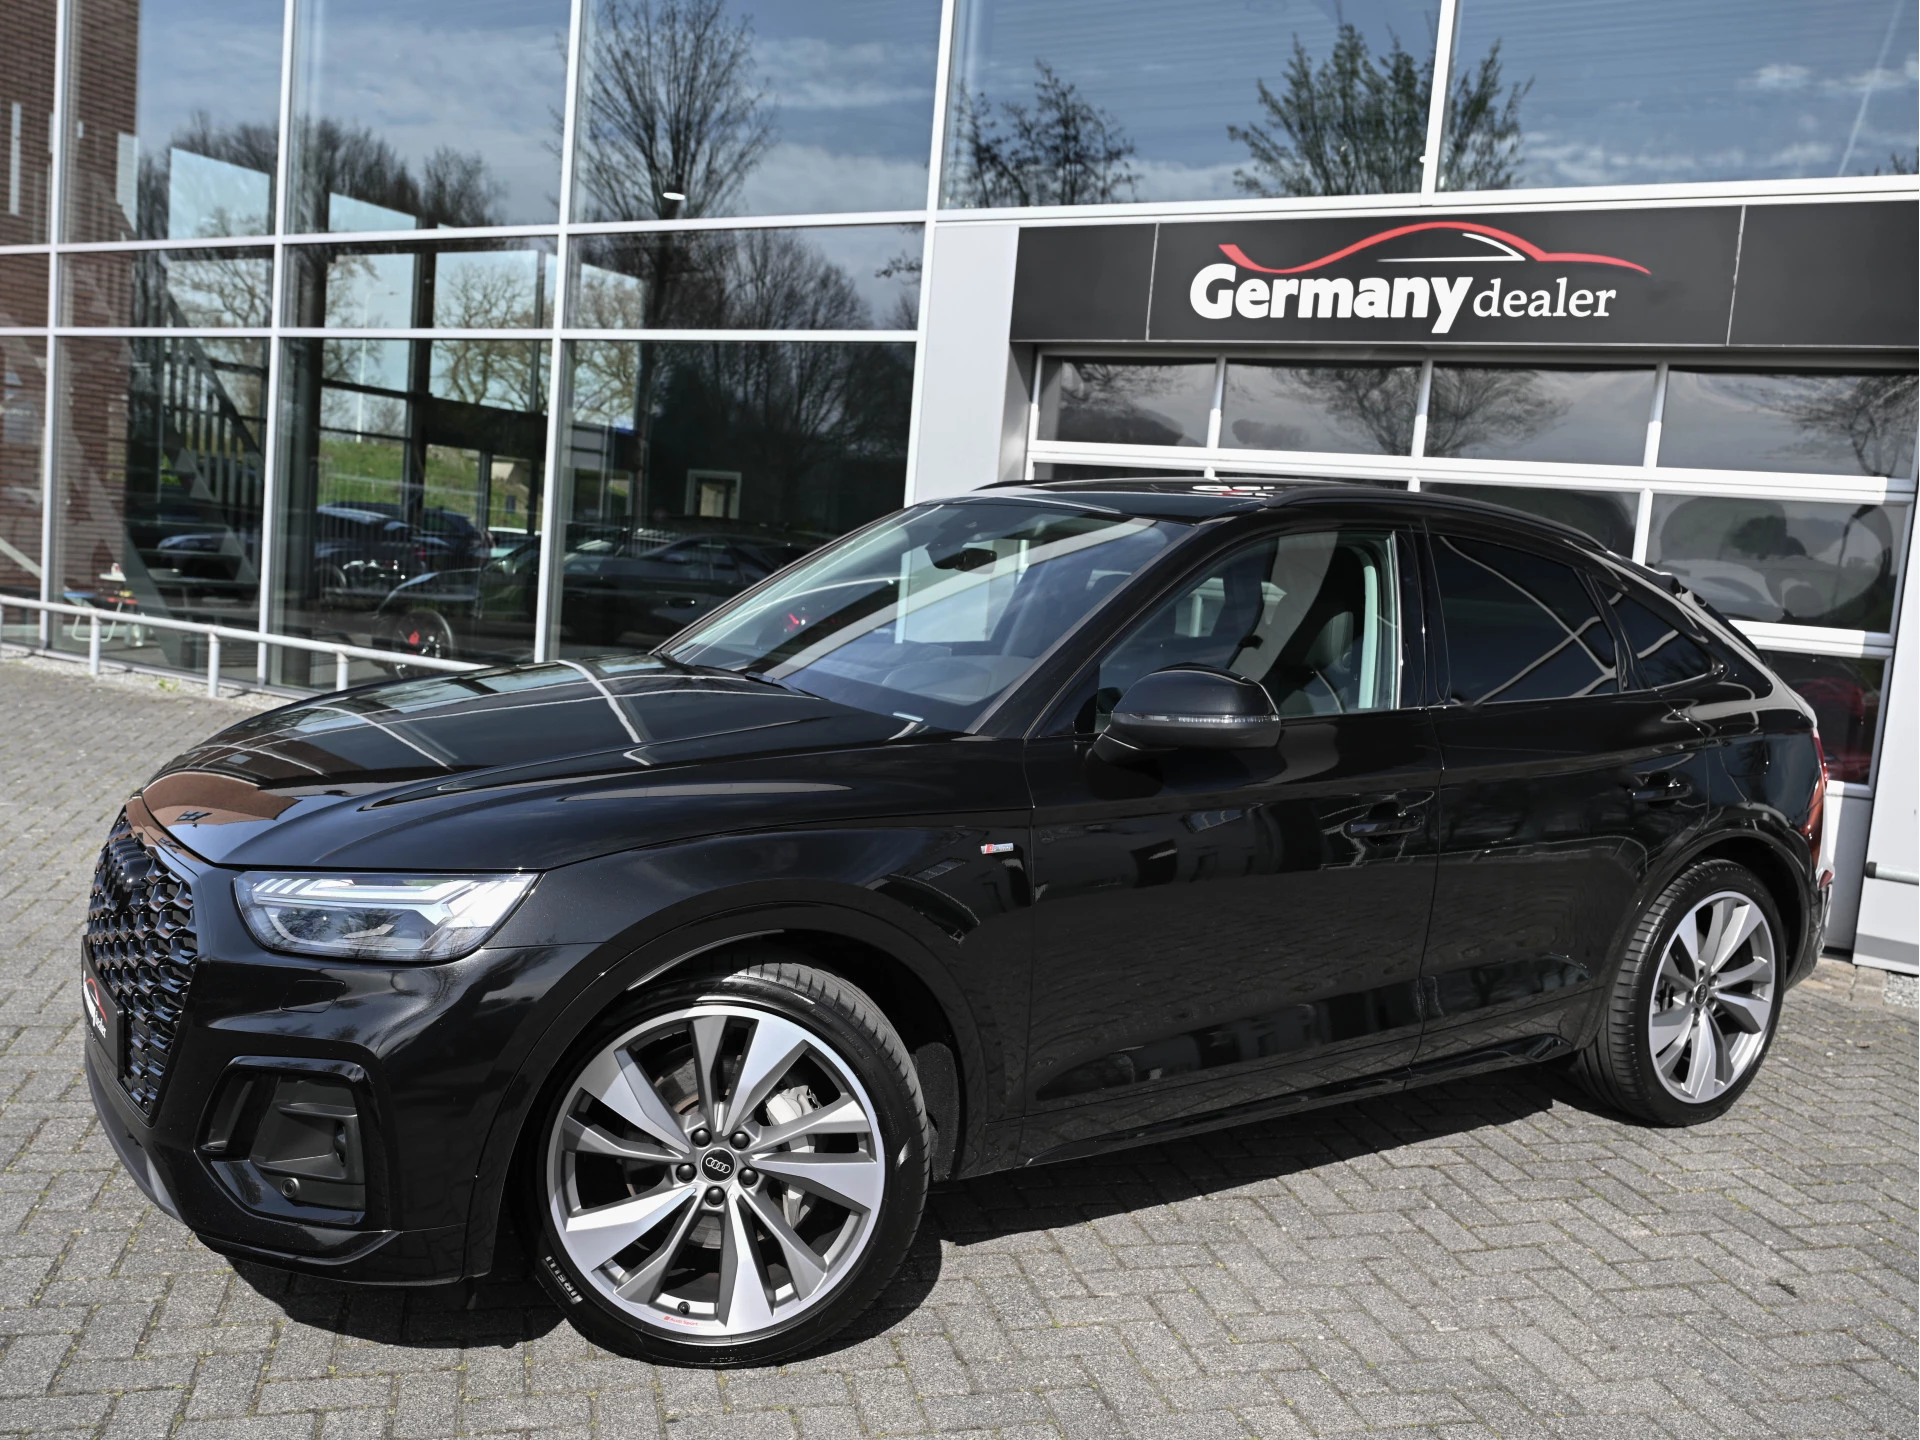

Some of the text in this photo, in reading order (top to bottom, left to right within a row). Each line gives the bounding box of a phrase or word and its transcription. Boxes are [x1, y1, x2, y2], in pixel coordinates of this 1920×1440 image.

[1190, 262, 1617, 334] Germany dealer
[543, 1256, 583, 1304] PIRELLI
